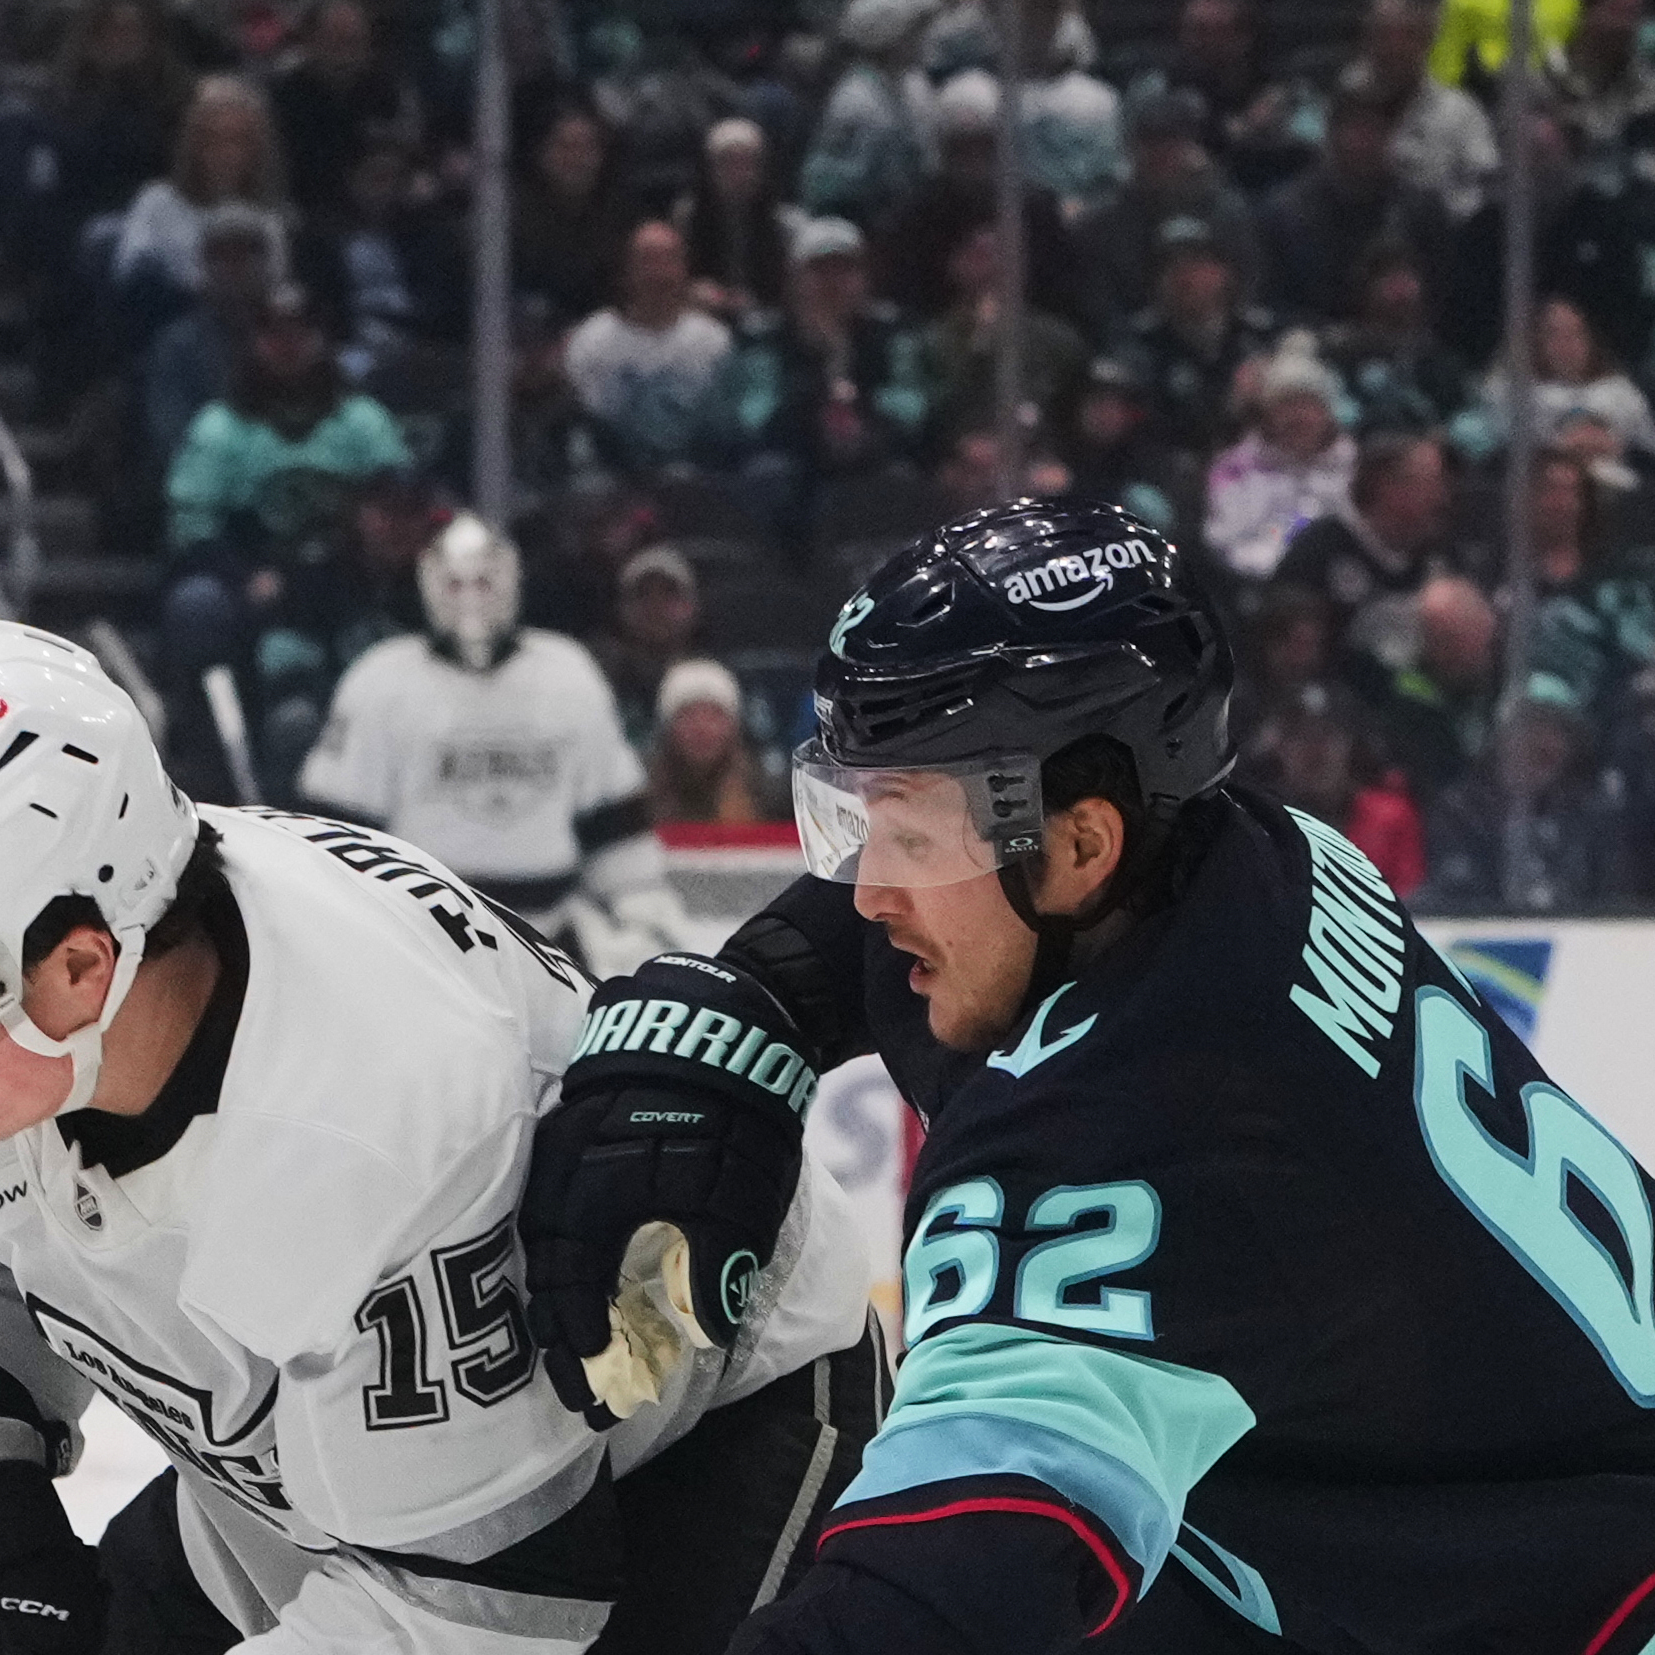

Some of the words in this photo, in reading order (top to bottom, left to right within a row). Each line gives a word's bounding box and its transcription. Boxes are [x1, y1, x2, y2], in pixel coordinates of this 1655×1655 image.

[1004, 538, 1157, 604] amazon
[630, 1111, 705, 1124] COVERT
[902, 1175, 1162, 1350] 62
[354, 1211, 538, 1431] 15
[1, 1597, 70, 1621] CCM
